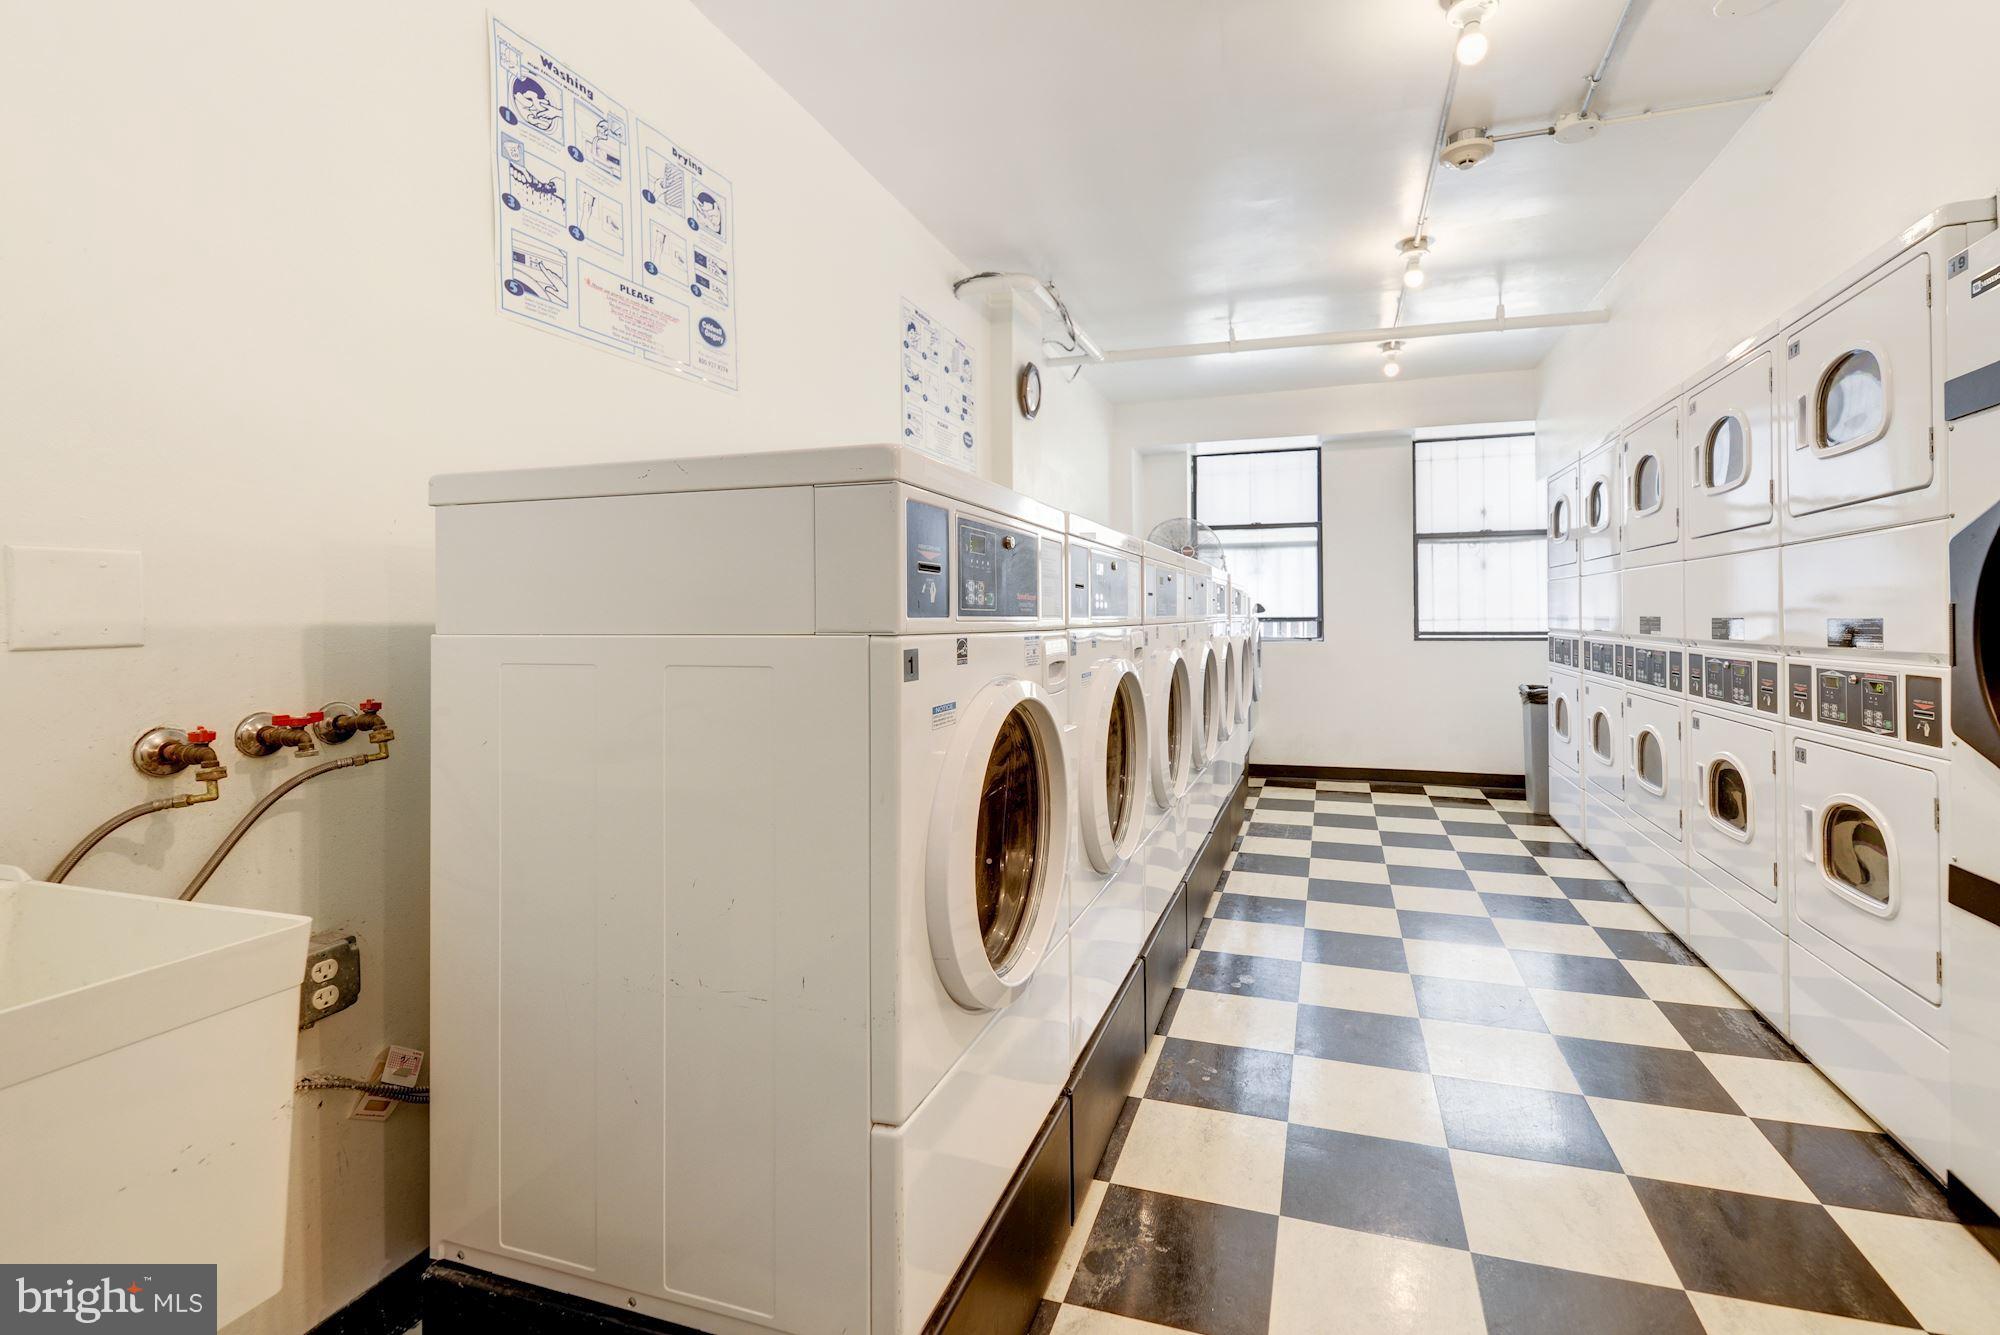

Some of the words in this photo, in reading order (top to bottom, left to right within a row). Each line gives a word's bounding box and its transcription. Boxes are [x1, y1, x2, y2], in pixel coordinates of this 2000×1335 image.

[540, 54, 594, 101] Washing
[672, 147, 703, 175] Drying
[507, 196, 516, 208] 3
[572, 227, 581, 239] 4
[1951, 255, 1966, 273] 19
[509, 281, 519, 294] 5
[619, 284, 655, 305] PLEASE
[908, 656, 914, 674] 1
[934, 703, 954, 714] NOTICE
